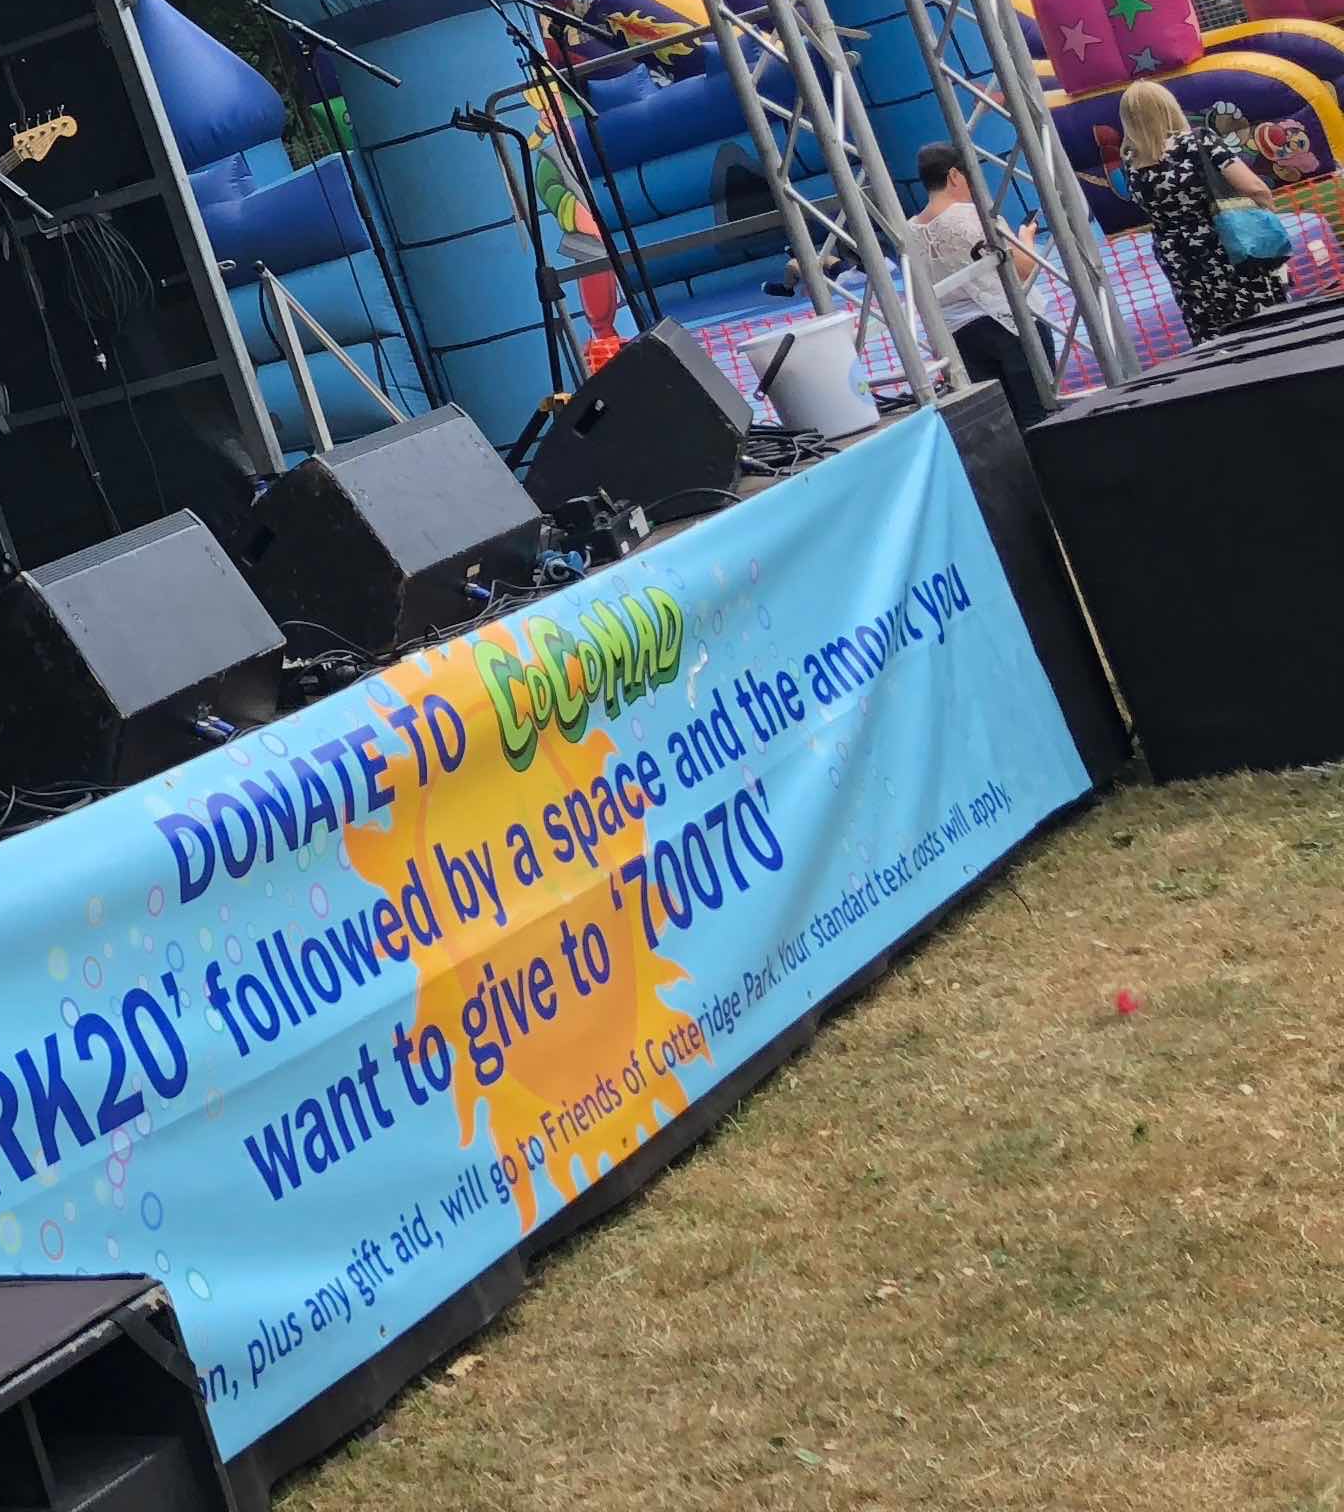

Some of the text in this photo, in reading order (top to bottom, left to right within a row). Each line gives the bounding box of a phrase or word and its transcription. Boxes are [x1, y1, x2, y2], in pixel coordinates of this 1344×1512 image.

[154, 724, 395, 904] DONATE
[389, 694, 465, 787] TO
[205, 857, 443, 1057] followed
[434, 841, 507, 926] by
[506, 823, 543, 886] a
[543, 750, 666, 868] space
[668, 688, 746, 789] and
[734, 669, 805, 743] the
[911, 562, 971, 645] you
[244, 1042, 395, 1201] want
[393, 1021, 452, 1106] to
[461, 957, 558, 1087] give
[560, 919, 611, 996] to
[247, 1311, 304, 1390] plus
[304, 1276, 352, 1332] any
[345, 1239, 394, 1306] gift
[389, 1203, 445, 1265] aid,
[440, 1163, 489, 1227] will
[489, 1154, 518, 1205] go
[516, 1135, 545, 1171] to
[540, 1073, 624, 1153] Friends
[621, 1048, 648, 1096] of
[645, 990, 742, 1077] Cotteridge
[742, 958, 782, 1008] Park.
[777, 928, 813, 977] Your
[809, 871, 881, 949] standard
[873, 851, 913, 897] text
[910, 829, 946, 875] costs
[940, 800, 972, 846] will
[968, 779, 1013, 828] apply.
